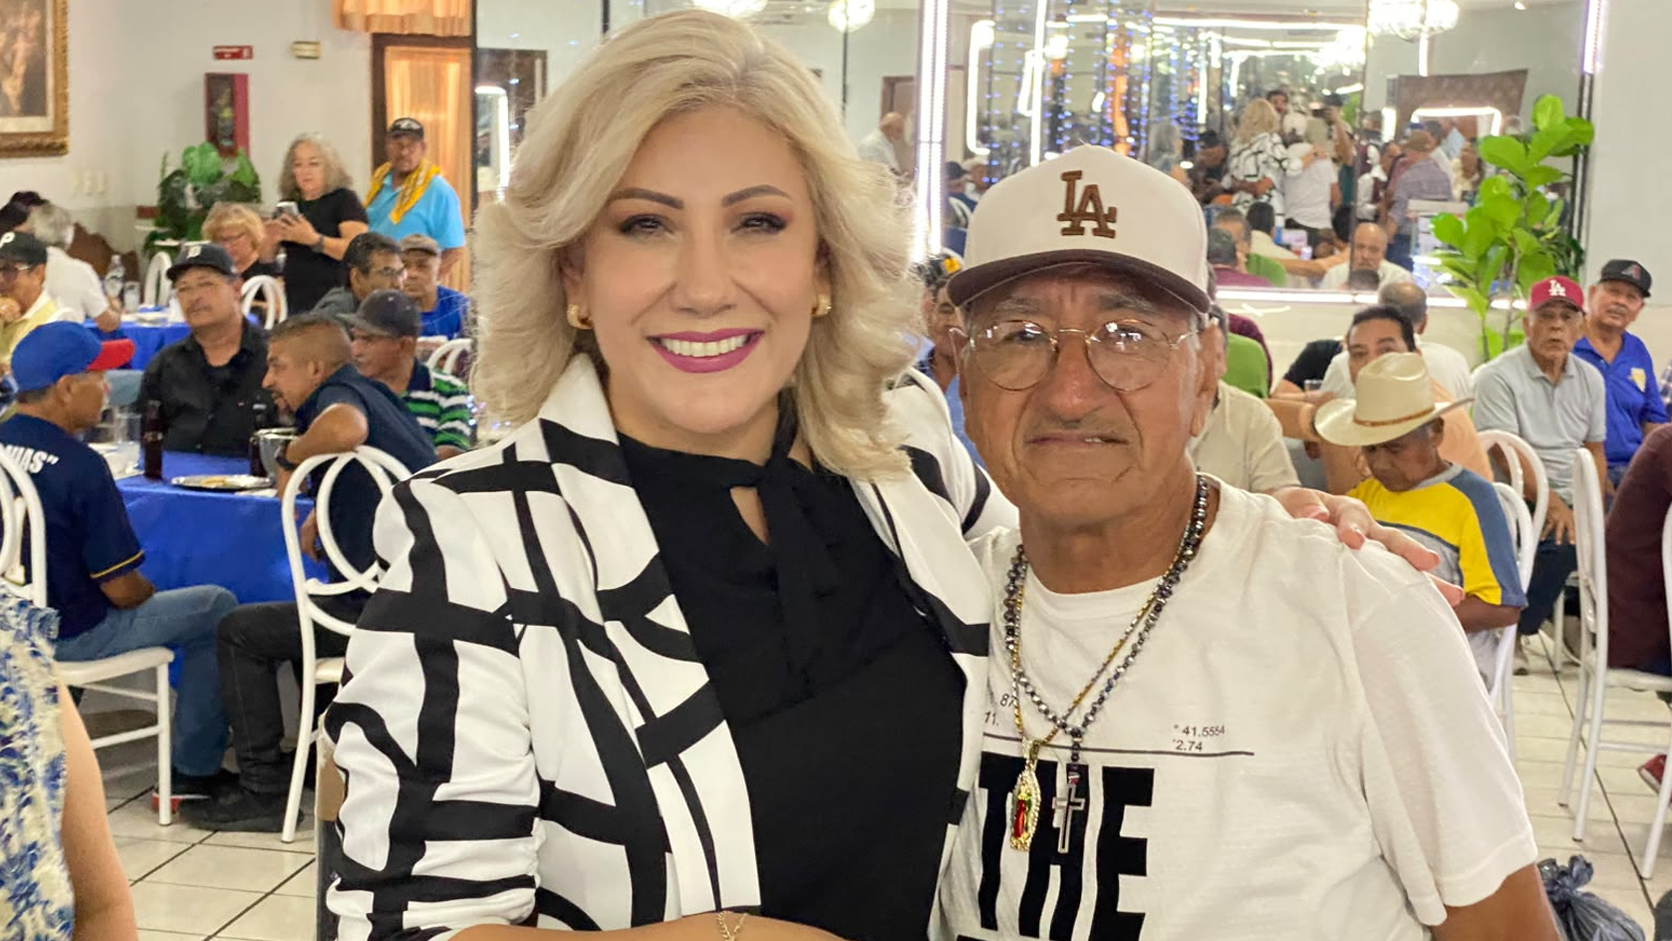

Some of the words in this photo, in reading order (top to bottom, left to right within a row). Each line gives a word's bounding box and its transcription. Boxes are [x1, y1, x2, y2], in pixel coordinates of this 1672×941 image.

[1057, 170, 1117, 239] LA
[1548, 279, 1567, 297] LA
[977, 751, 1155, 941] THE
